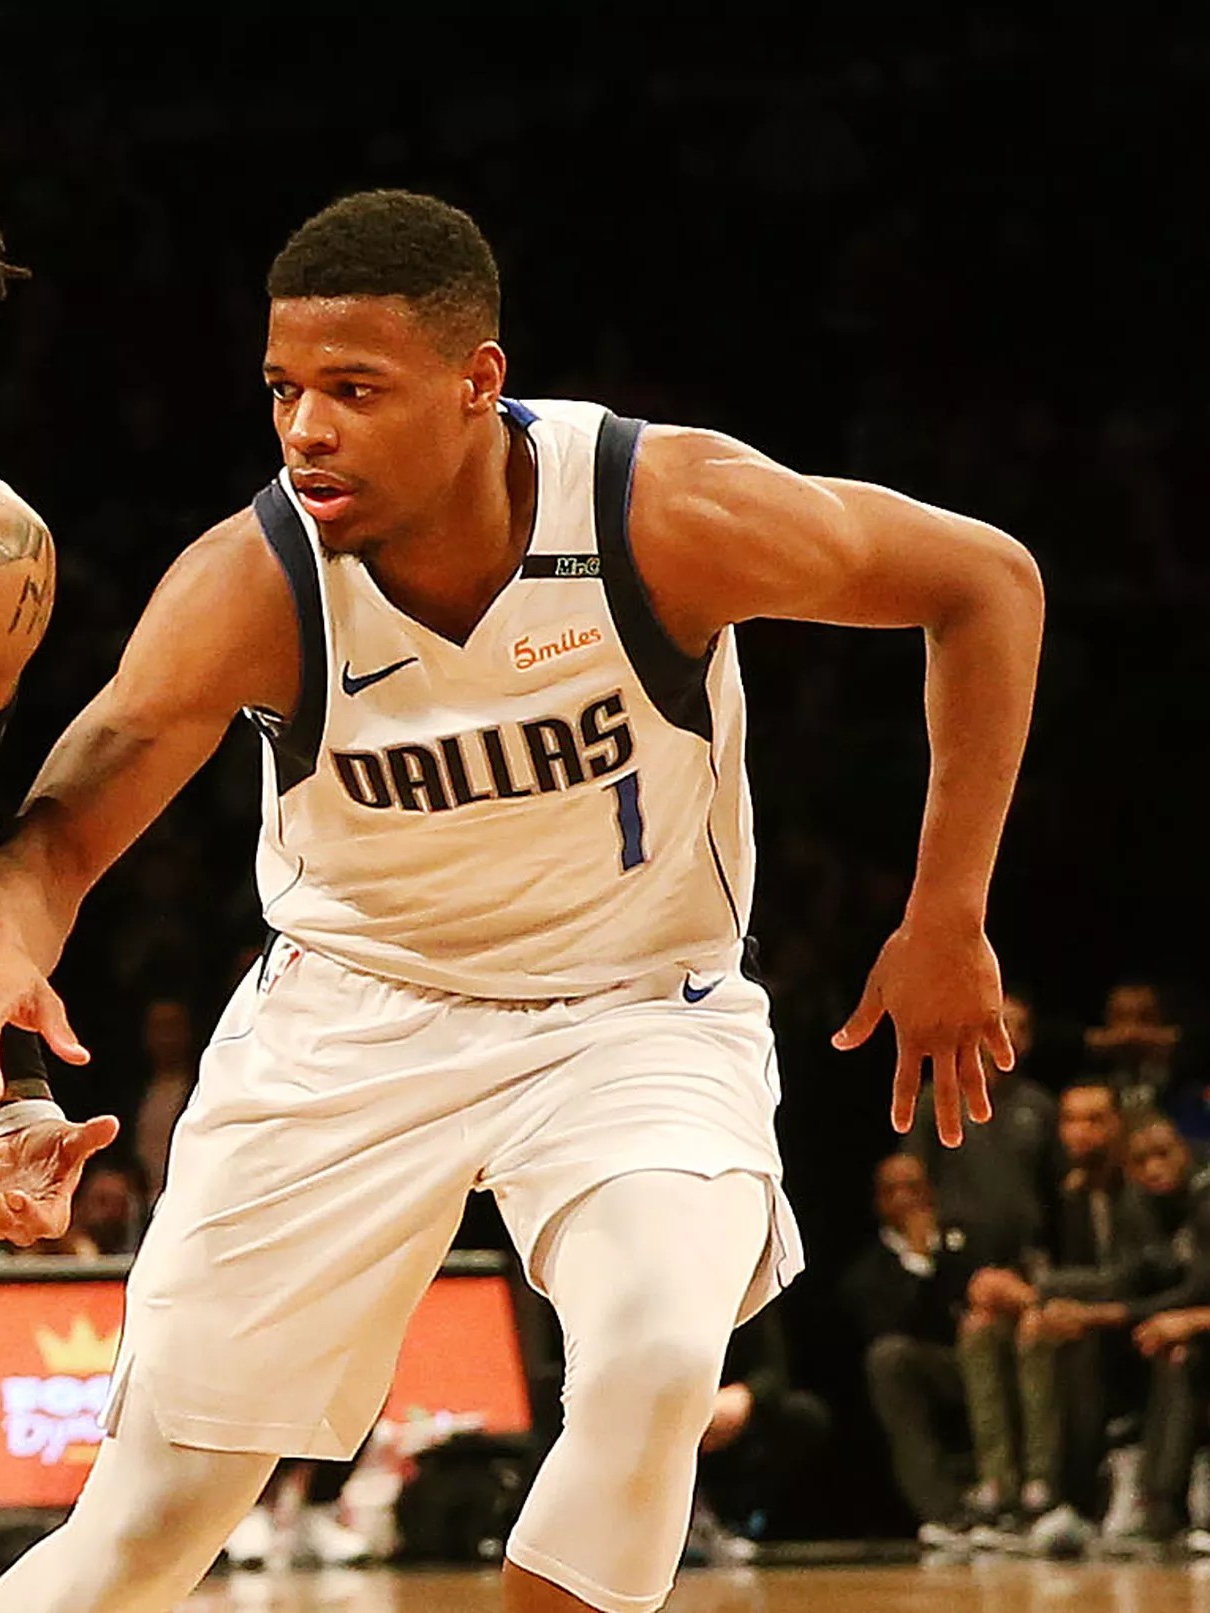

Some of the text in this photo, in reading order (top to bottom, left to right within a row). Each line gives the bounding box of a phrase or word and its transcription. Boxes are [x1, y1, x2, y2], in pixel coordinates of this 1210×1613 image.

[513, 627, 603, 670] 5miles
[330, 687, 637, 816] DALLAS
[601, 769, 649, 876] 1
